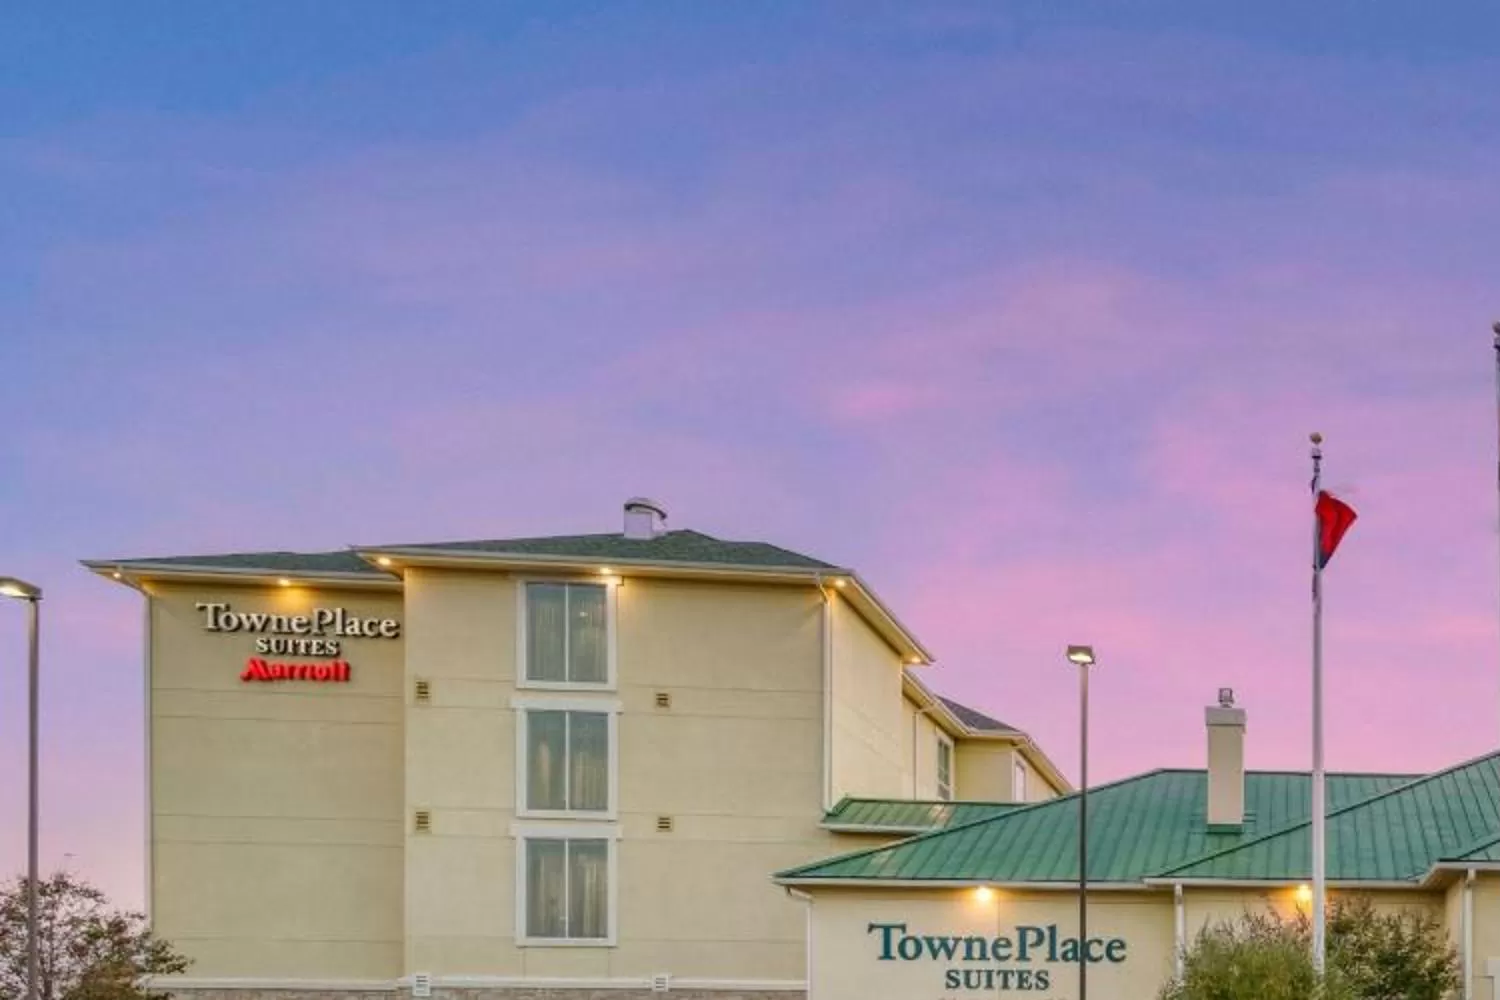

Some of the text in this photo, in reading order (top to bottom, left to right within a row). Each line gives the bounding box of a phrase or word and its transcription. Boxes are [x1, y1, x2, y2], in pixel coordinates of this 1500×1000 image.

[195, 602, 399, 637] TownePlace
[255, 637, 338, 656] SUITES
[240, 657, 352, 683] Marriott
[867, 922, 1127, 963] TownePlace
[945, 969, 1050, 991] SUITES
